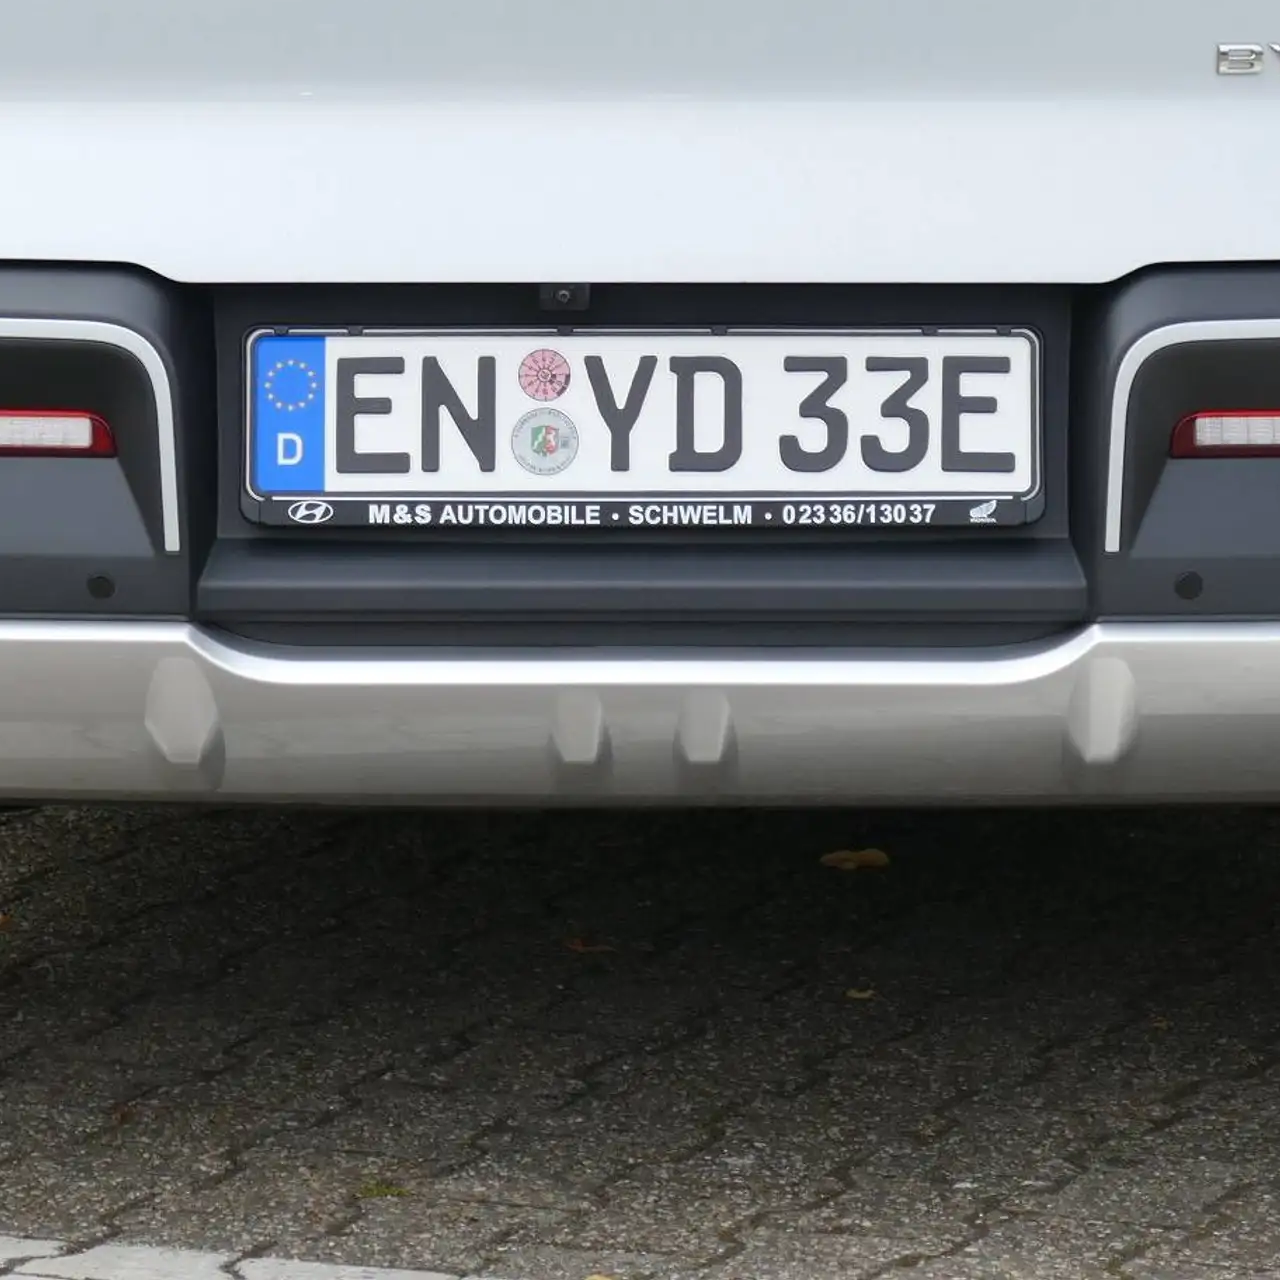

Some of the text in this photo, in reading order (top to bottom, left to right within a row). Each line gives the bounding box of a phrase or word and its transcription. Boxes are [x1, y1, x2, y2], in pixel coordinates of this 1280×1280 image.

[335, 356, 496, 474] EN
[584, 355, 743, 473] YD
[779, 356, 1016, 473] 33E
[276, 432, 303, 466] D
[368, 503, 936, 524] M&S AUTOMOBILE SCHWELM 02336/13037
